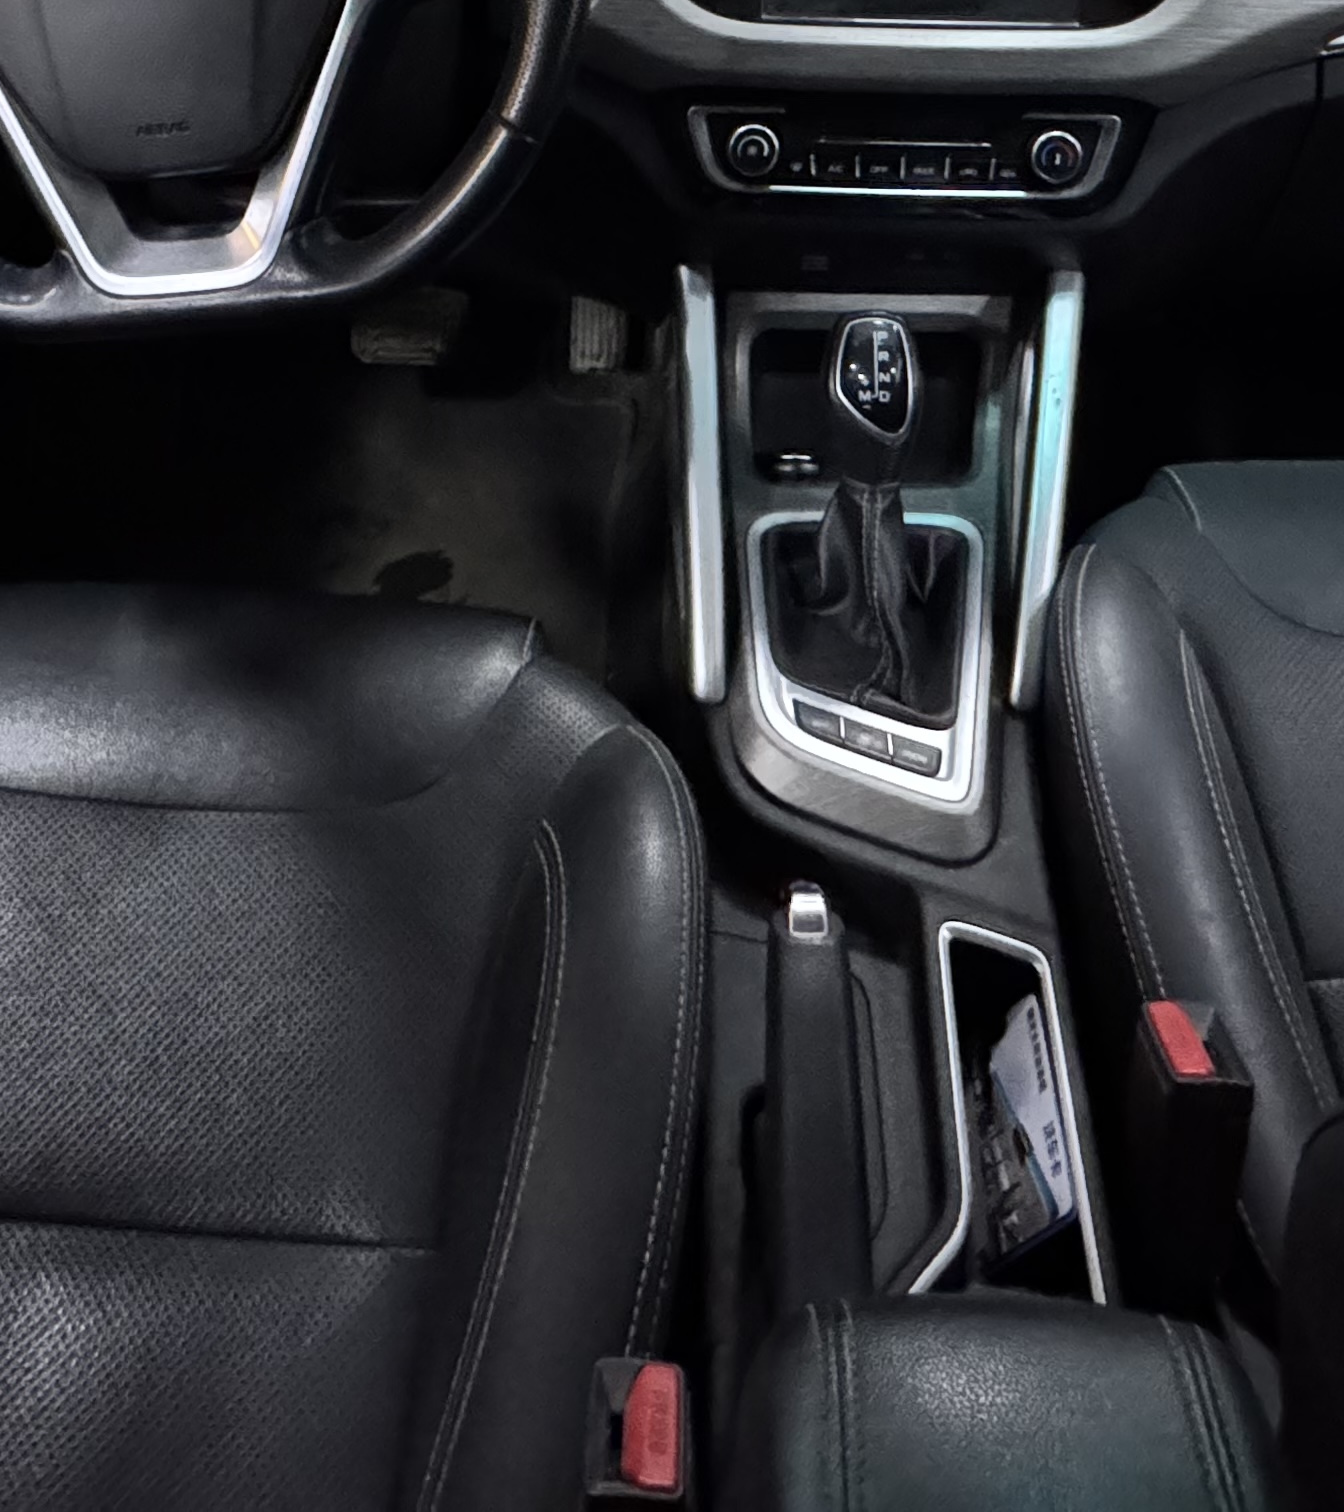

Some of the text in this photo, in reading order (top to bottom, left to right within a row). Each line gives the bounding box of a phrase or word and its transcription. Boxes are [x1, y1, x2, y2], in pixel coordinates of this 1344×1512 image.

[877, 330, 889, 345] P
[878, 350, 890, 362] R
[879, 371, 892, 384] N
[858, 389, 872, 402] M
[879, 390, 891, 403] D
